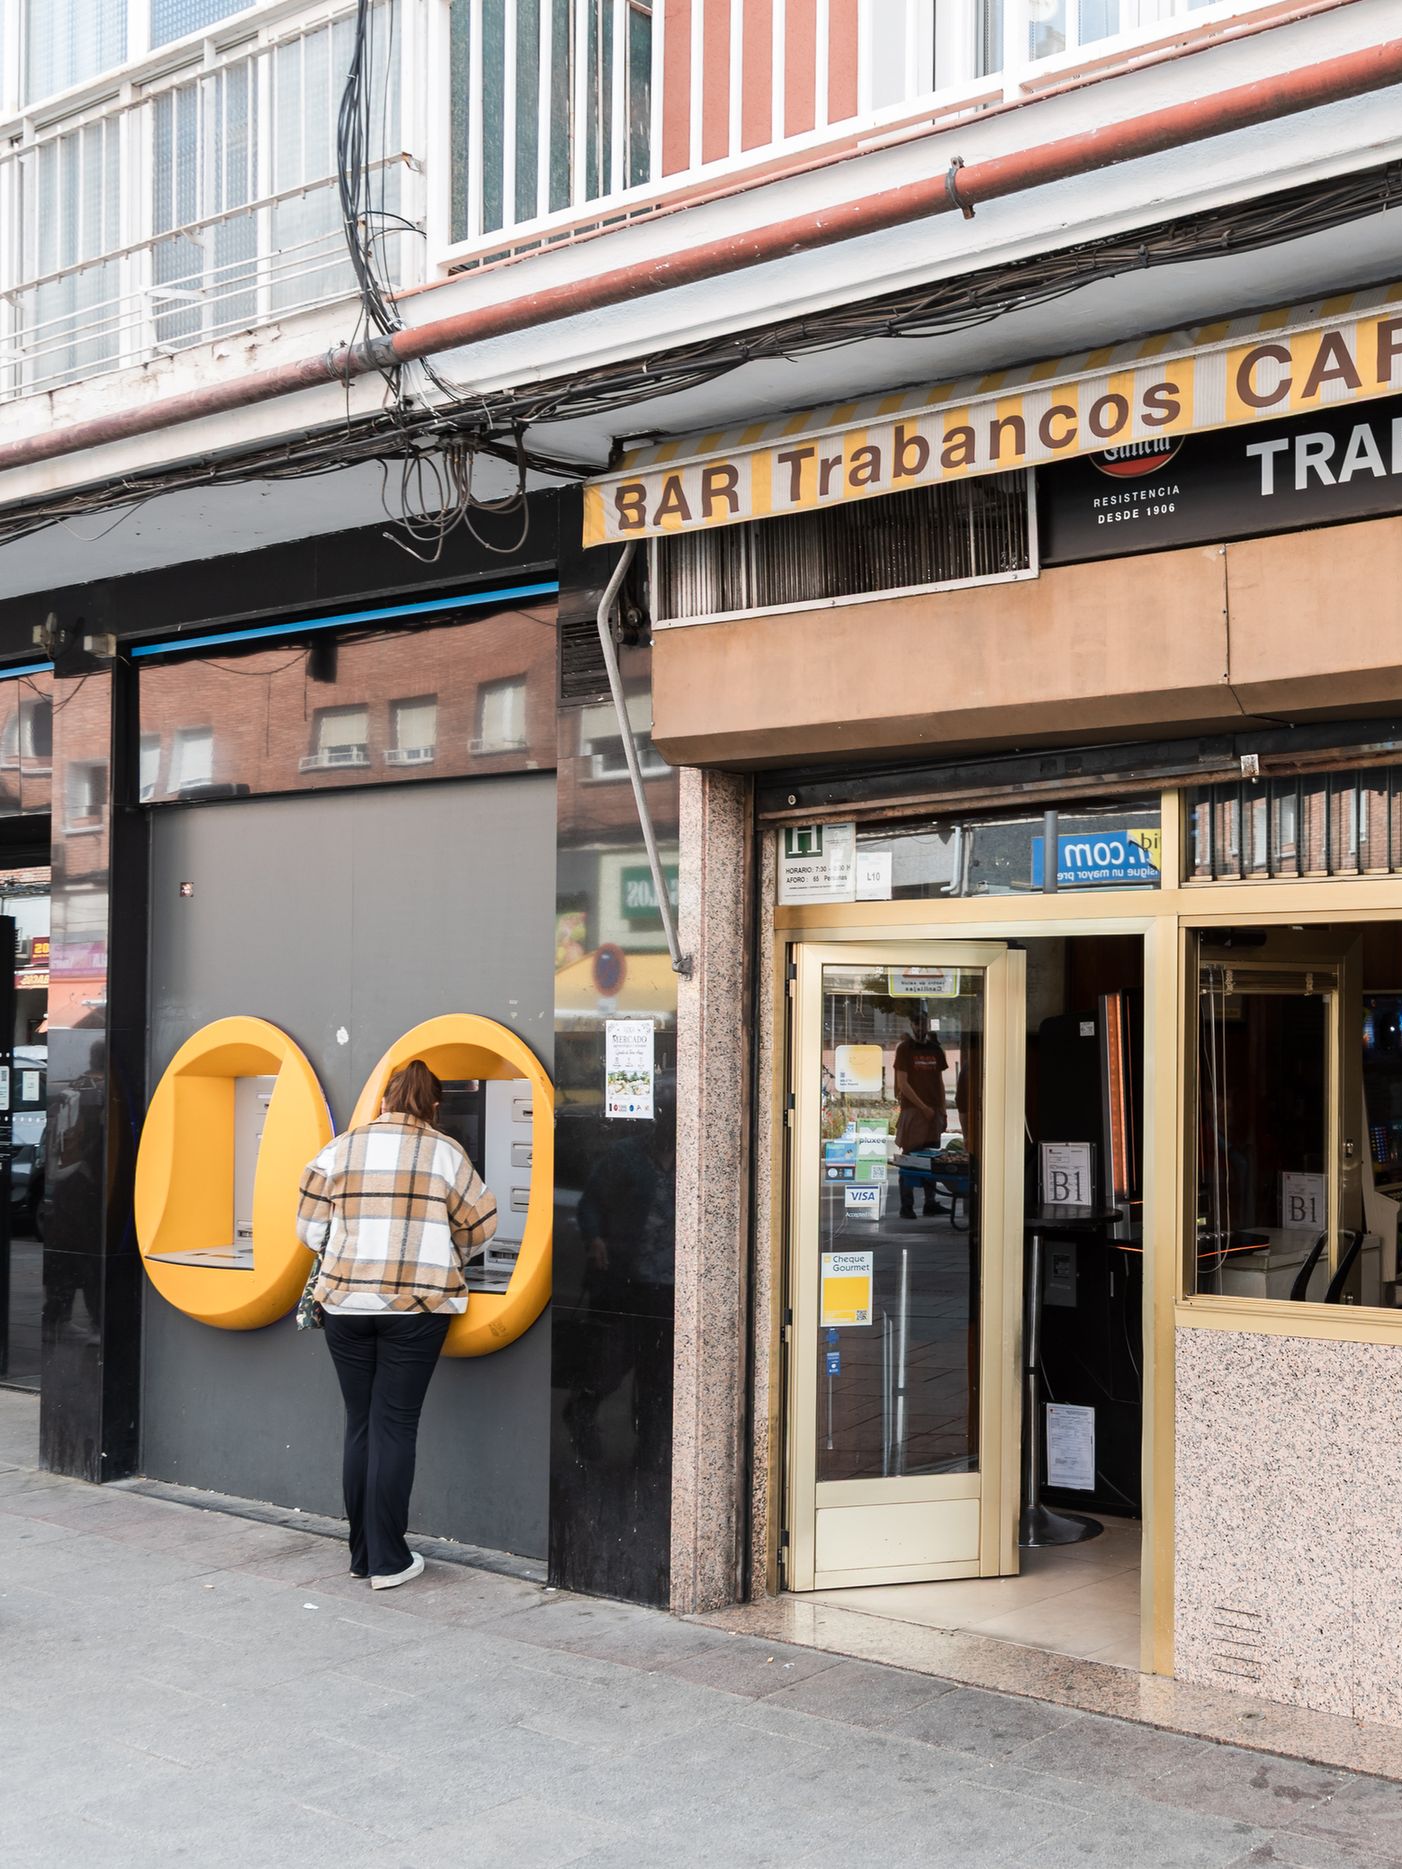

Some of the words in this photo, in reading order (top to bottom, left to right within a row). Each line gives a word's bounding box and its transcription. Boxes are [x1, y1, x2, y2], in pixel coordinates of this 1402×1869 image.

[616, 464, 740, 531] BAR
[778, 381, 1182, 502] Trabancos
[1093, 484, 1180, 508] RESISTENCIA
[1098, 508, 1140, 525] DESDE
[1146, 502, 1176, 516] 1906
[867, 872, 881, 881] L10
[851, 1192, 875, 1200] VISA
[1050, 1170, 1083, 1202] B1
[1289, 1196, 1319, 1223] B1
[833, 1255, 865, 1263] Cheque
[833, 1263, 870, 1272] Gourmet
